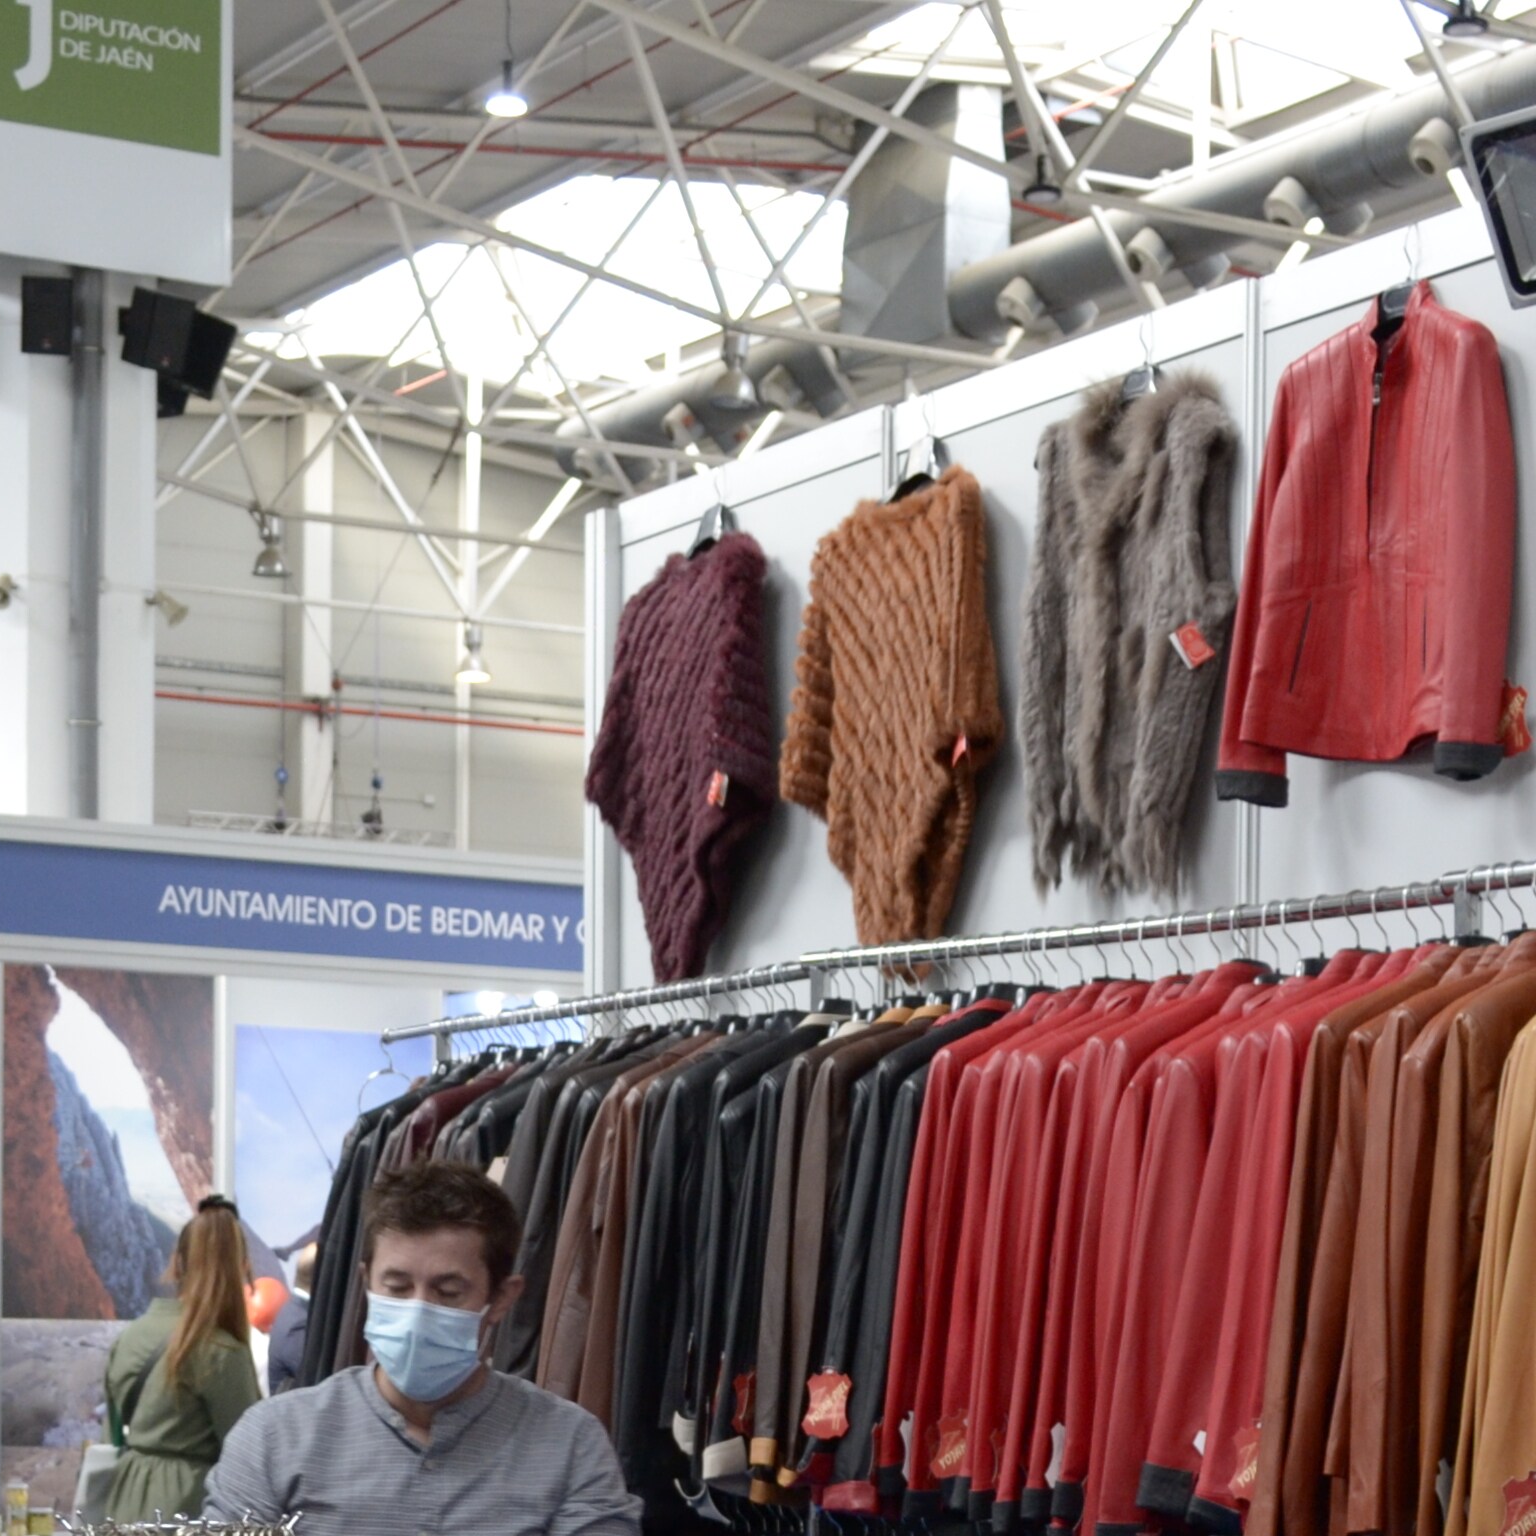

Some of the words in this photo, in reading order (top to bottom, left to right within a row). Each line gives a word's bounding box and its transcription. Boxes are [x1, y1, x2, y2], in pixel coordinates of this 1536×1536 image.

[60, 10, 201, 53] DIPUTACIÓN
[60, 37, 91, 62] DE
[95, 45, 153, 71] JAÉN
[159, 884, 376, 931] AYUNTAMIENTO
[386, 902, 421, 934] DE
[430, 905, 543, 942] BEDMAR
[553, 917, 567, 943] Y
